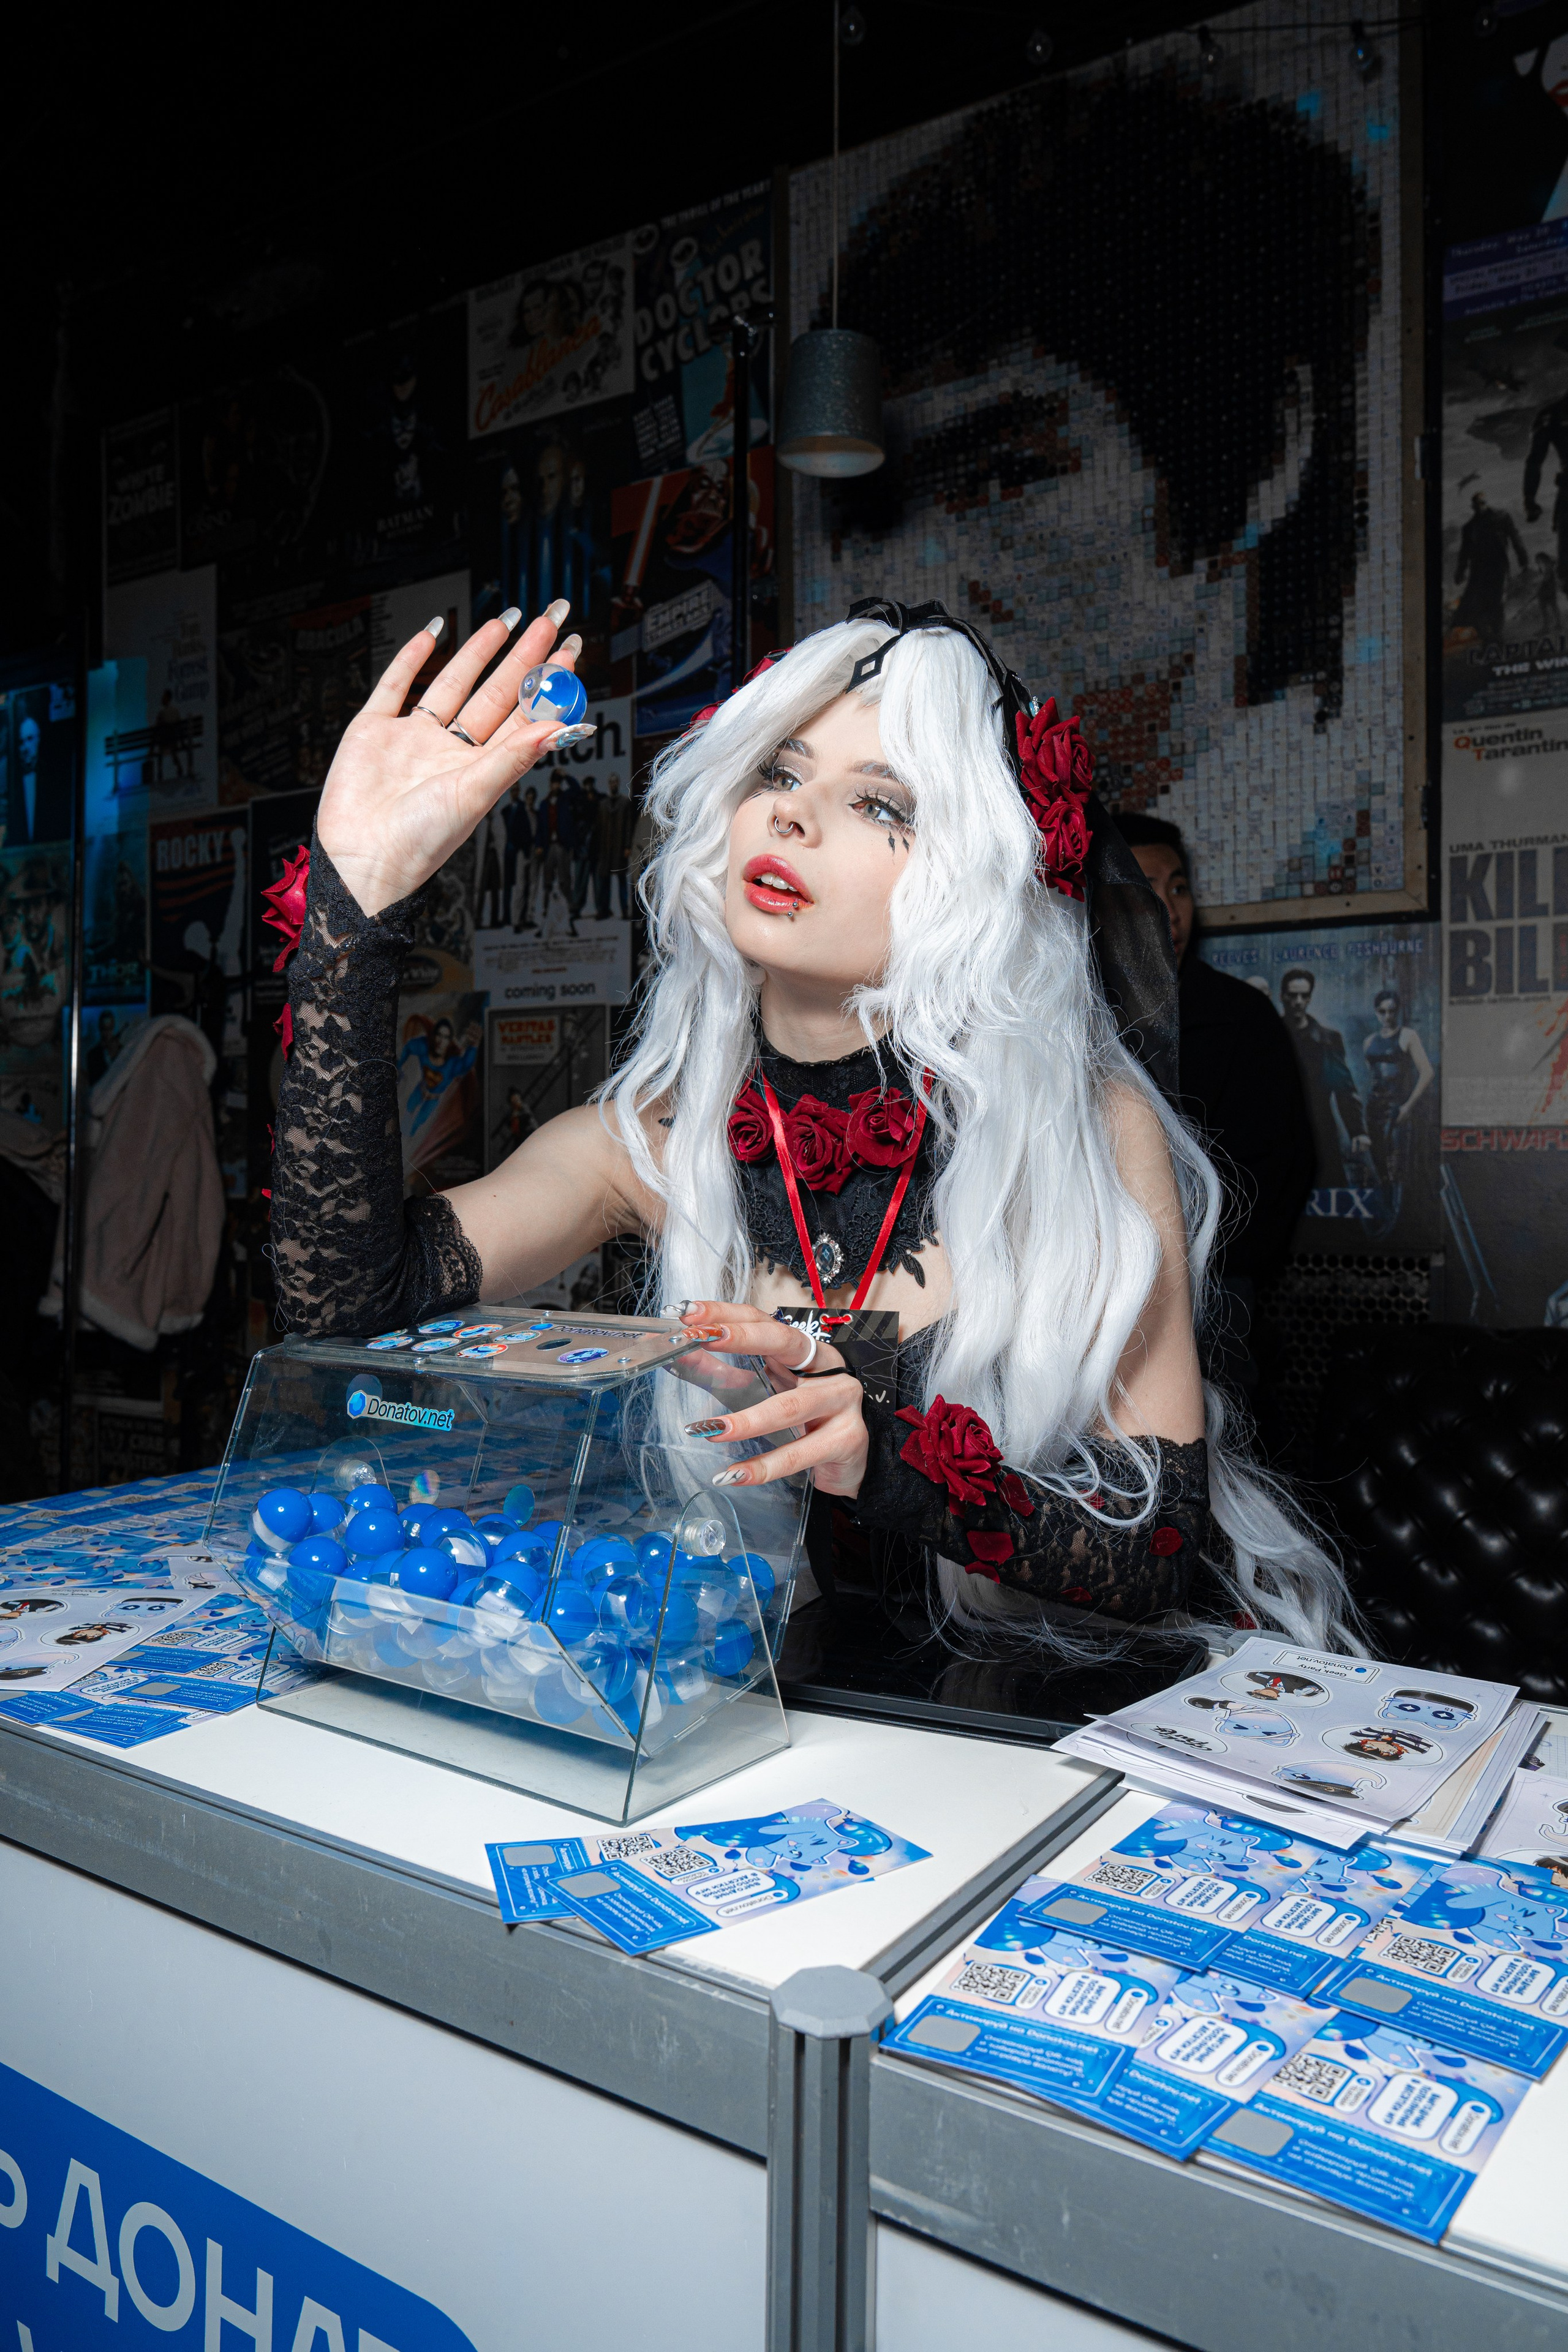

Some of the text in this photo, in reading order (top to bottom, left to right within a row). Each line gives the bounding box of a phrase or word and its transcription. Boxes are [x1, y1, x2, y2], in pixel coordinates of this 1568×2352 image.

[633, 238, 765, 345] DOCTOR
[476, 315, 601, 431] Casablanca
[106, 480, 176, 526] ZOMBIE
[377, 503, 434, 533] BATMAN
[1491, 662, 1531, 676] THE
[1454, 728, 1544, 750] Quentin
[156, 830, 225, 872] ROCKY
[1449, 842, 1485, 854] UMA
[1272, 943, 1340, 964] LAURENCE
[1347, 939, 1423, 959] FISHBURNE
[505, 982, 595, 1001] coming soon
[550, 1325, 643, 1339] Donatov.net
[368, 1398, 454, 1429] Donatov.net
[1296, 1656, 1354, 1671] Donatov.net
[1298, 1664, 1322, 1672] Party
[209, 1685, 249, 1694] Donatov.net
[611, 1872, 644, 1894] Активируй
[650, 1897, 690, 1924] Donatov.net
[1077, 1894, 1131, 1912] Активируй
[1147, 1912, 1208, 1935] Donatov.net
[1243, 1935, 1308, 1959] Donatov.net
